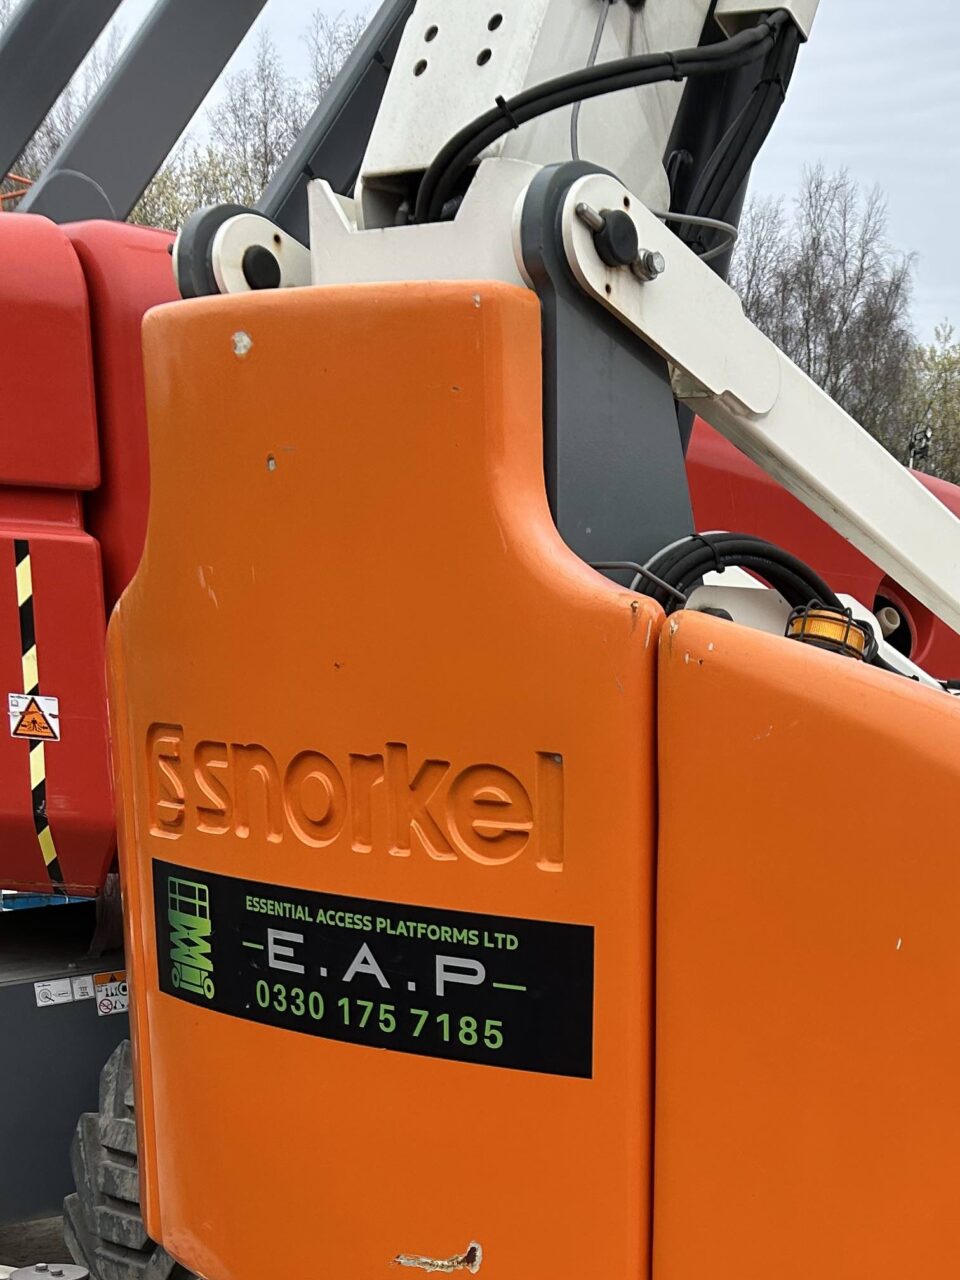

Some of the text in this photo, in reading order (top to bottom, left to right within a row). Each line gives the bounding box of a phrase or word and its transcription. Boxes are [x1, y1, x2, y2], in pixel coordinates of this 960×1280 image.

[245, 895, 519, 951] ESSENTIAL ACCESS PLATFORMS LTD
[256, 979, 504, 1049] 0330 175 7185
